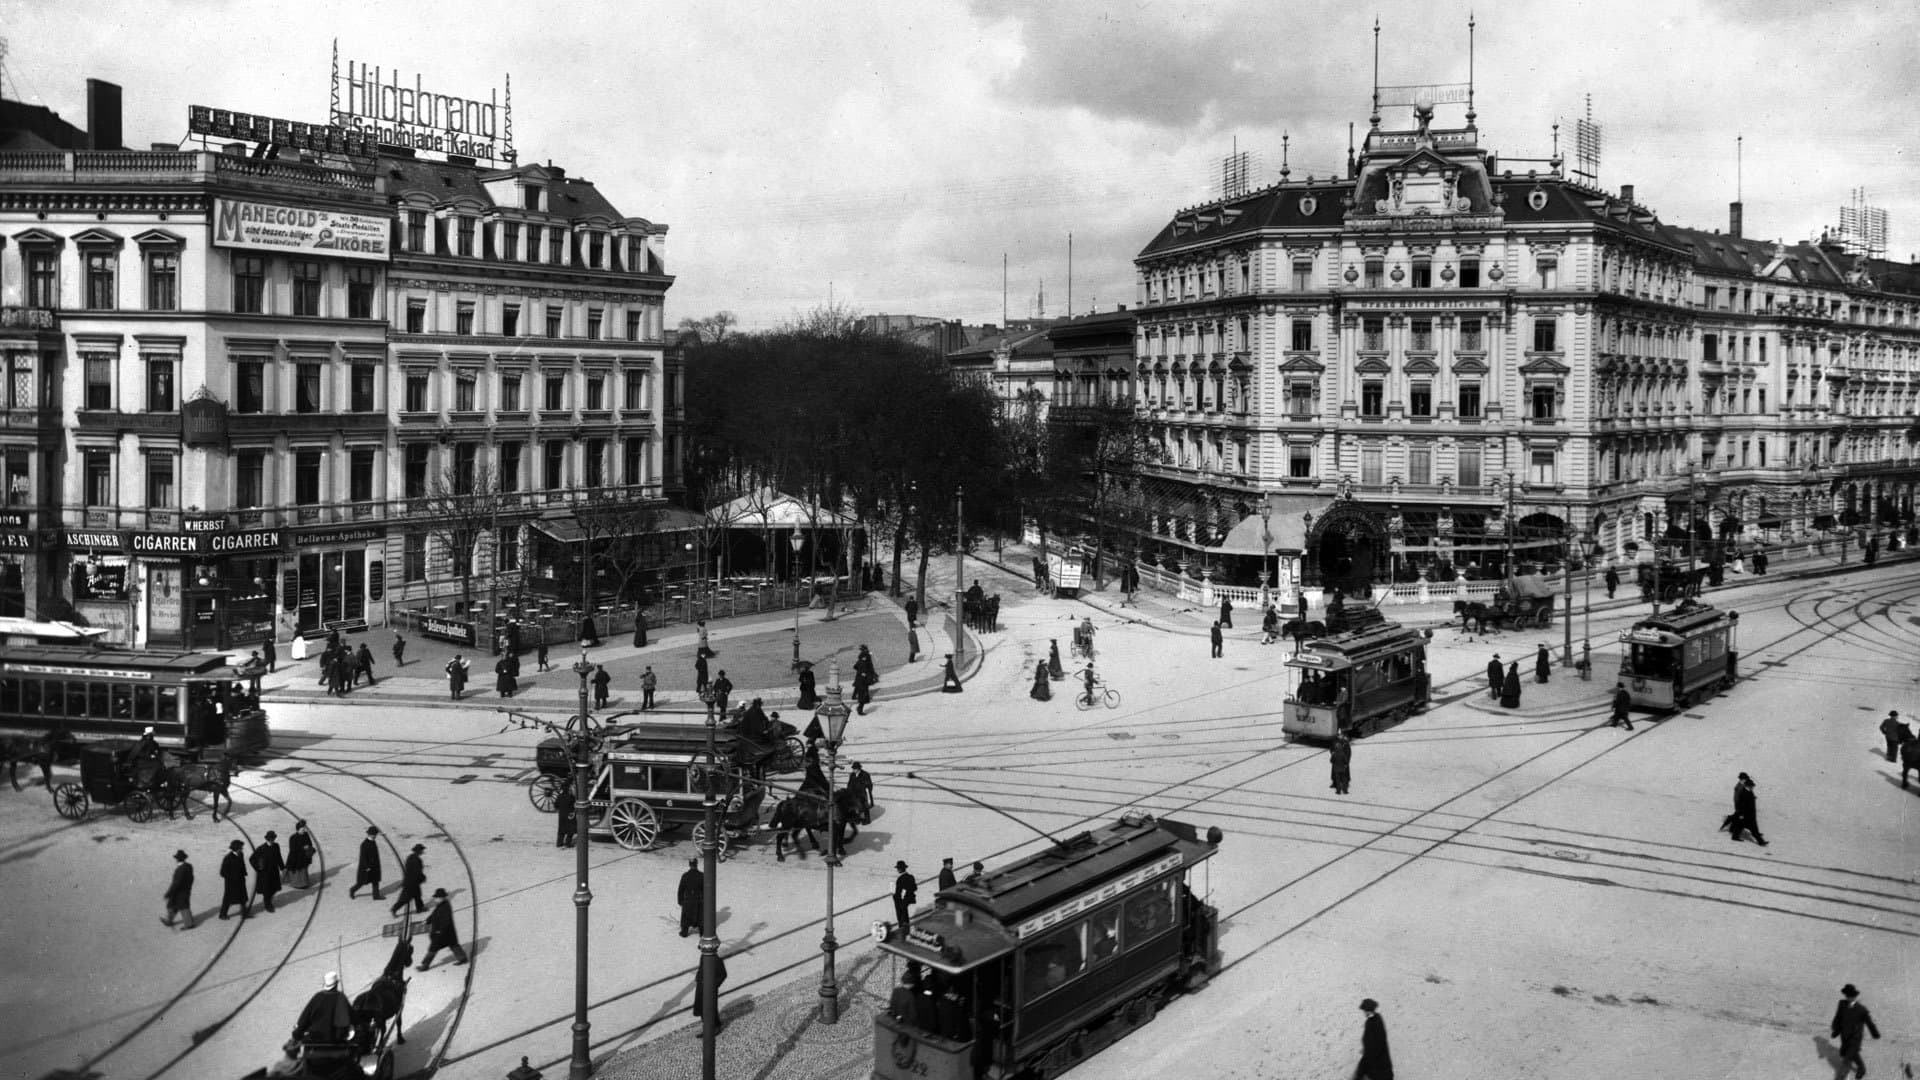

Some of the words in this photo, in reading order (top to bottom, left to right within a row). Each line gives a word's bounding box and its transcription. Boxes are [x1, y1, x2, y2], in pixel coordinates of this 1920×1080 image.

[349, 60, 497, 141] Hildebrand
[66, 533, 120, 547] ASCHINGER
[134, 534, 197, 551] CIGARREN
[212, 532, 279, 551] CIGARREN
